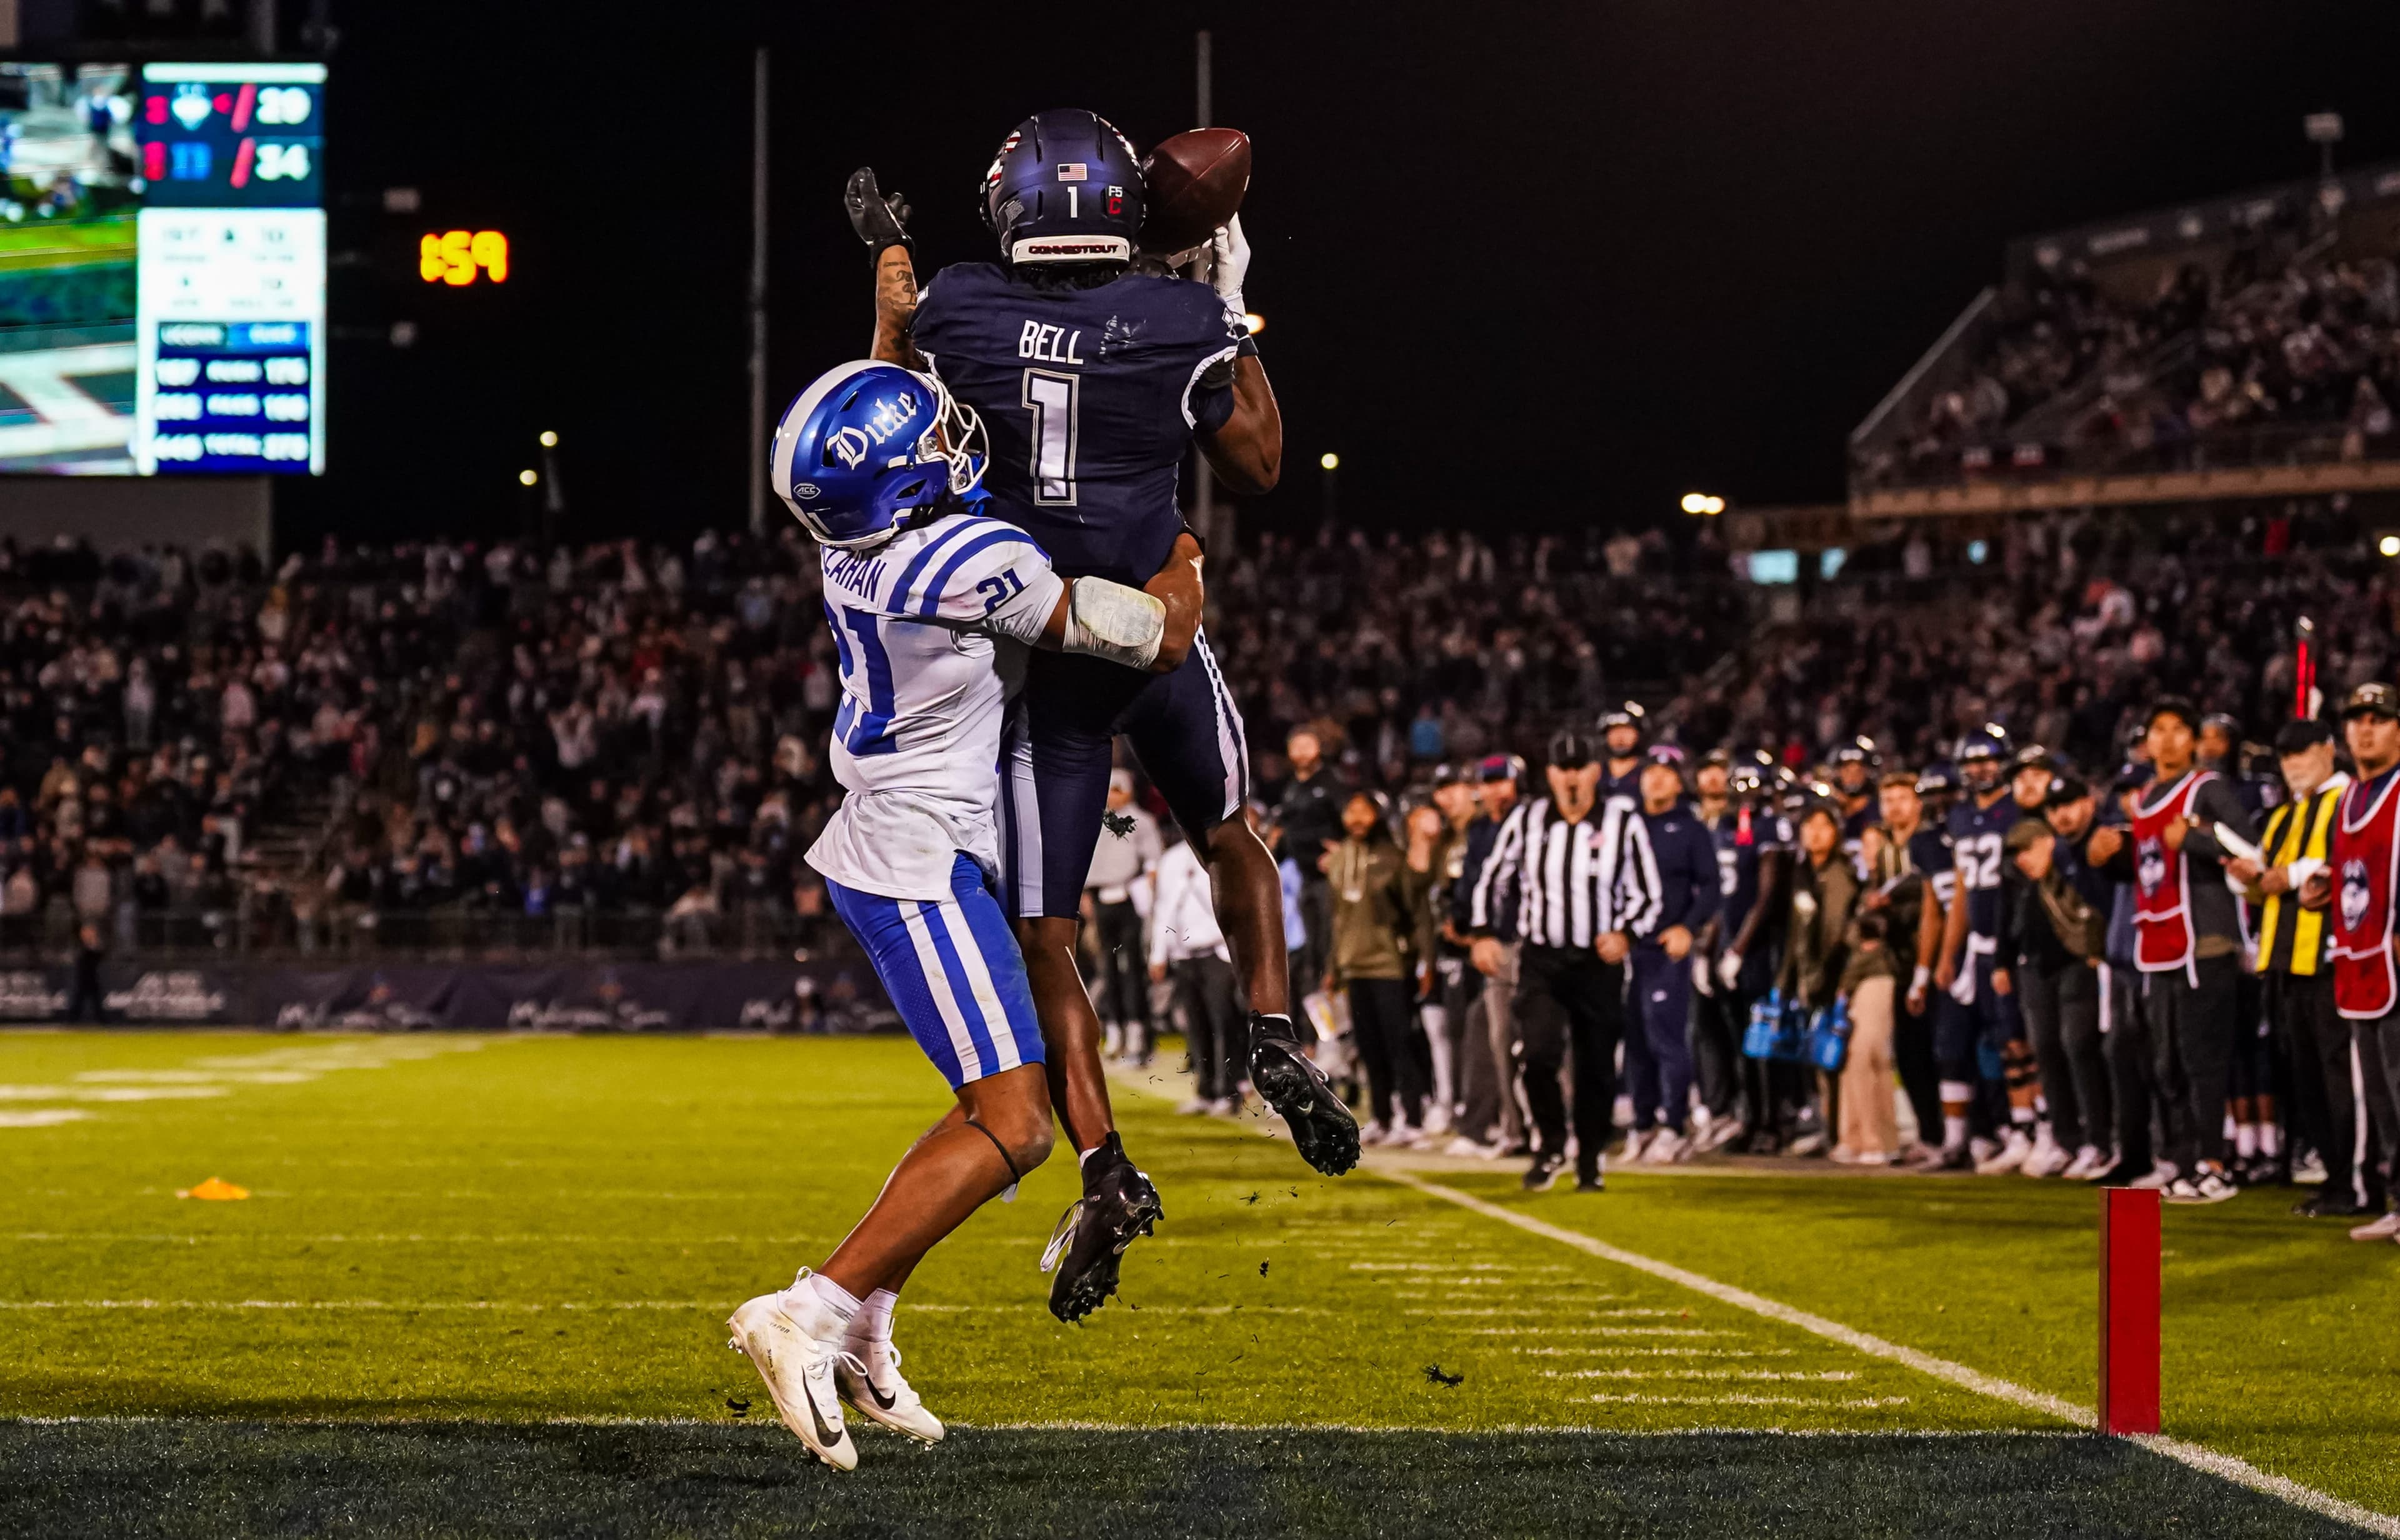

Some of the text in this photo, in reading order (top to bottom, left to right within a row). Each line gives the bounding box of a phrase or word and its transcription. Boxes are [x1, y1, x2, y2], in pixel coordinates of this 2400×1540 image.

[1068, 186, 1078, 218] 1
[1109, 185, 1122, 198] F5
[1109, 198, 1122, 214] C
[421, 230, 508, 285] 1:59
[1028, 244, 1119, 254] CONNECTICUT
[1019, 319, 1084, 364] BELL
[826, 392, 917, 470] Duke
[1021, 367, 1080, 507] 1
[821, 544, 887, 602] LAHAN
[976, 568, 1024, 615] 21
[1954, 832, 2002, 889] 52
